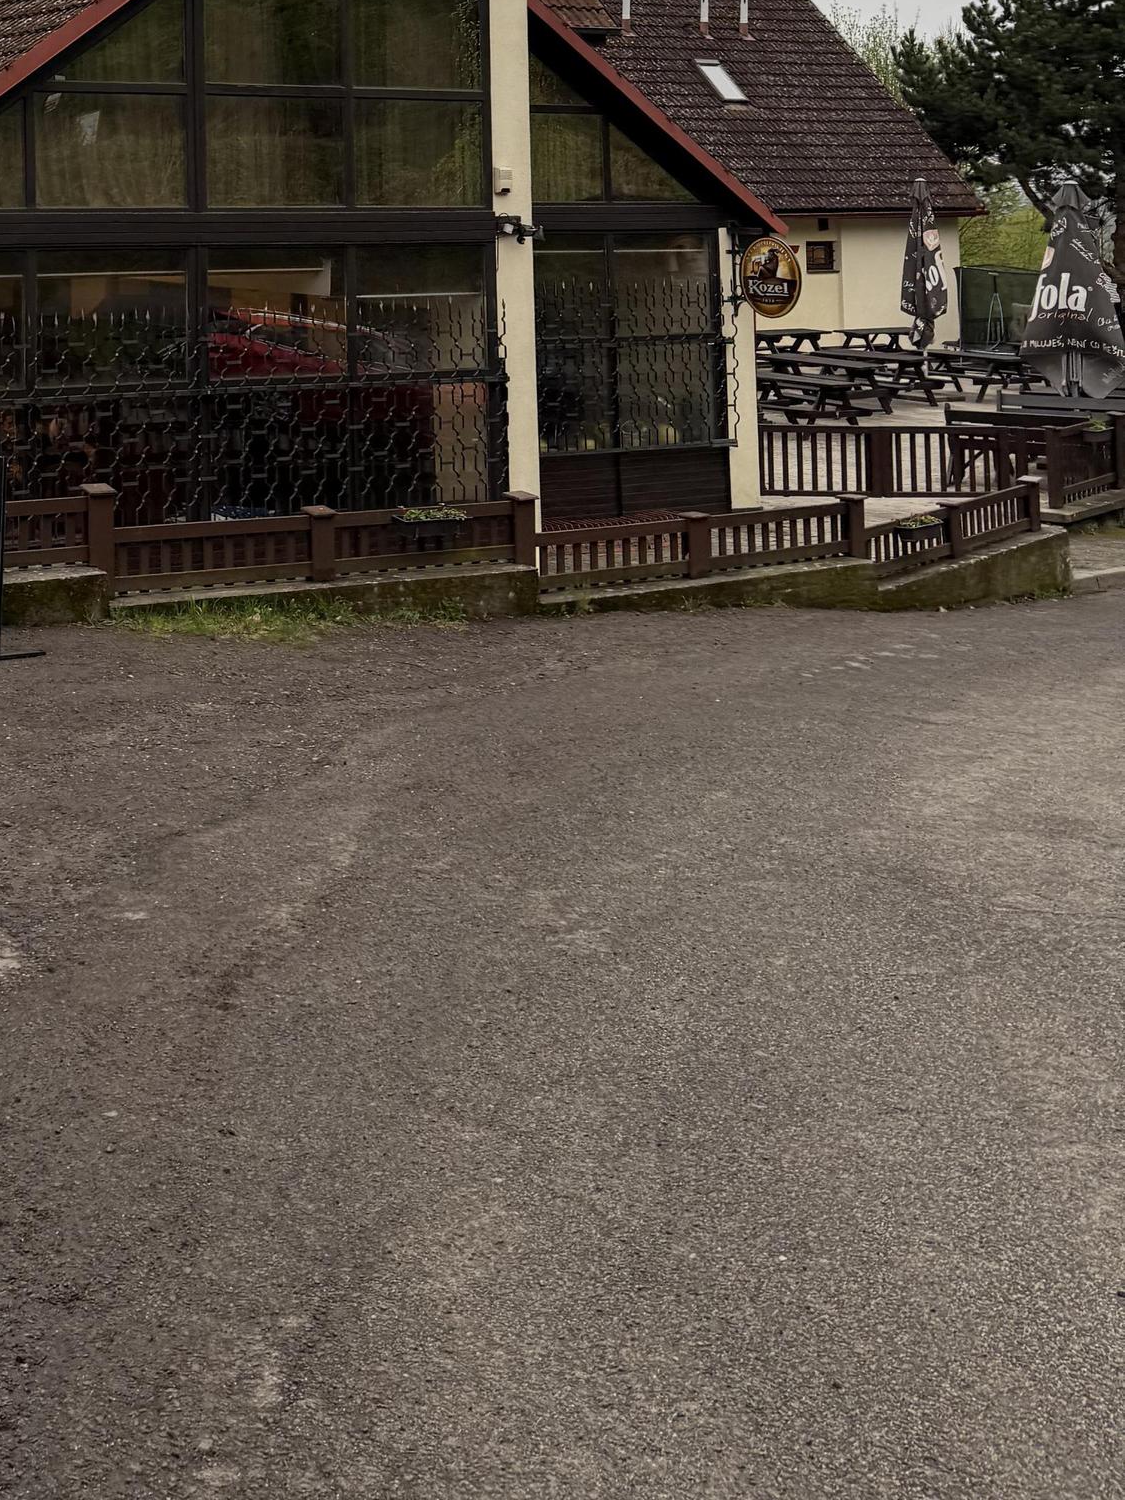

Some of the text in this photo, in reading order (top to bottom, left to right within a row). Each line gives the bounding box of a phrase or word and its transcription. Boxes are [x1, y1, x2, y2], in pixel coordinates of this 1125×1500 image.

[748, 279, 790, 297] Kozel
[1028, 272, 1087, 322] fola
[1037, 308, 1093, 326] original
